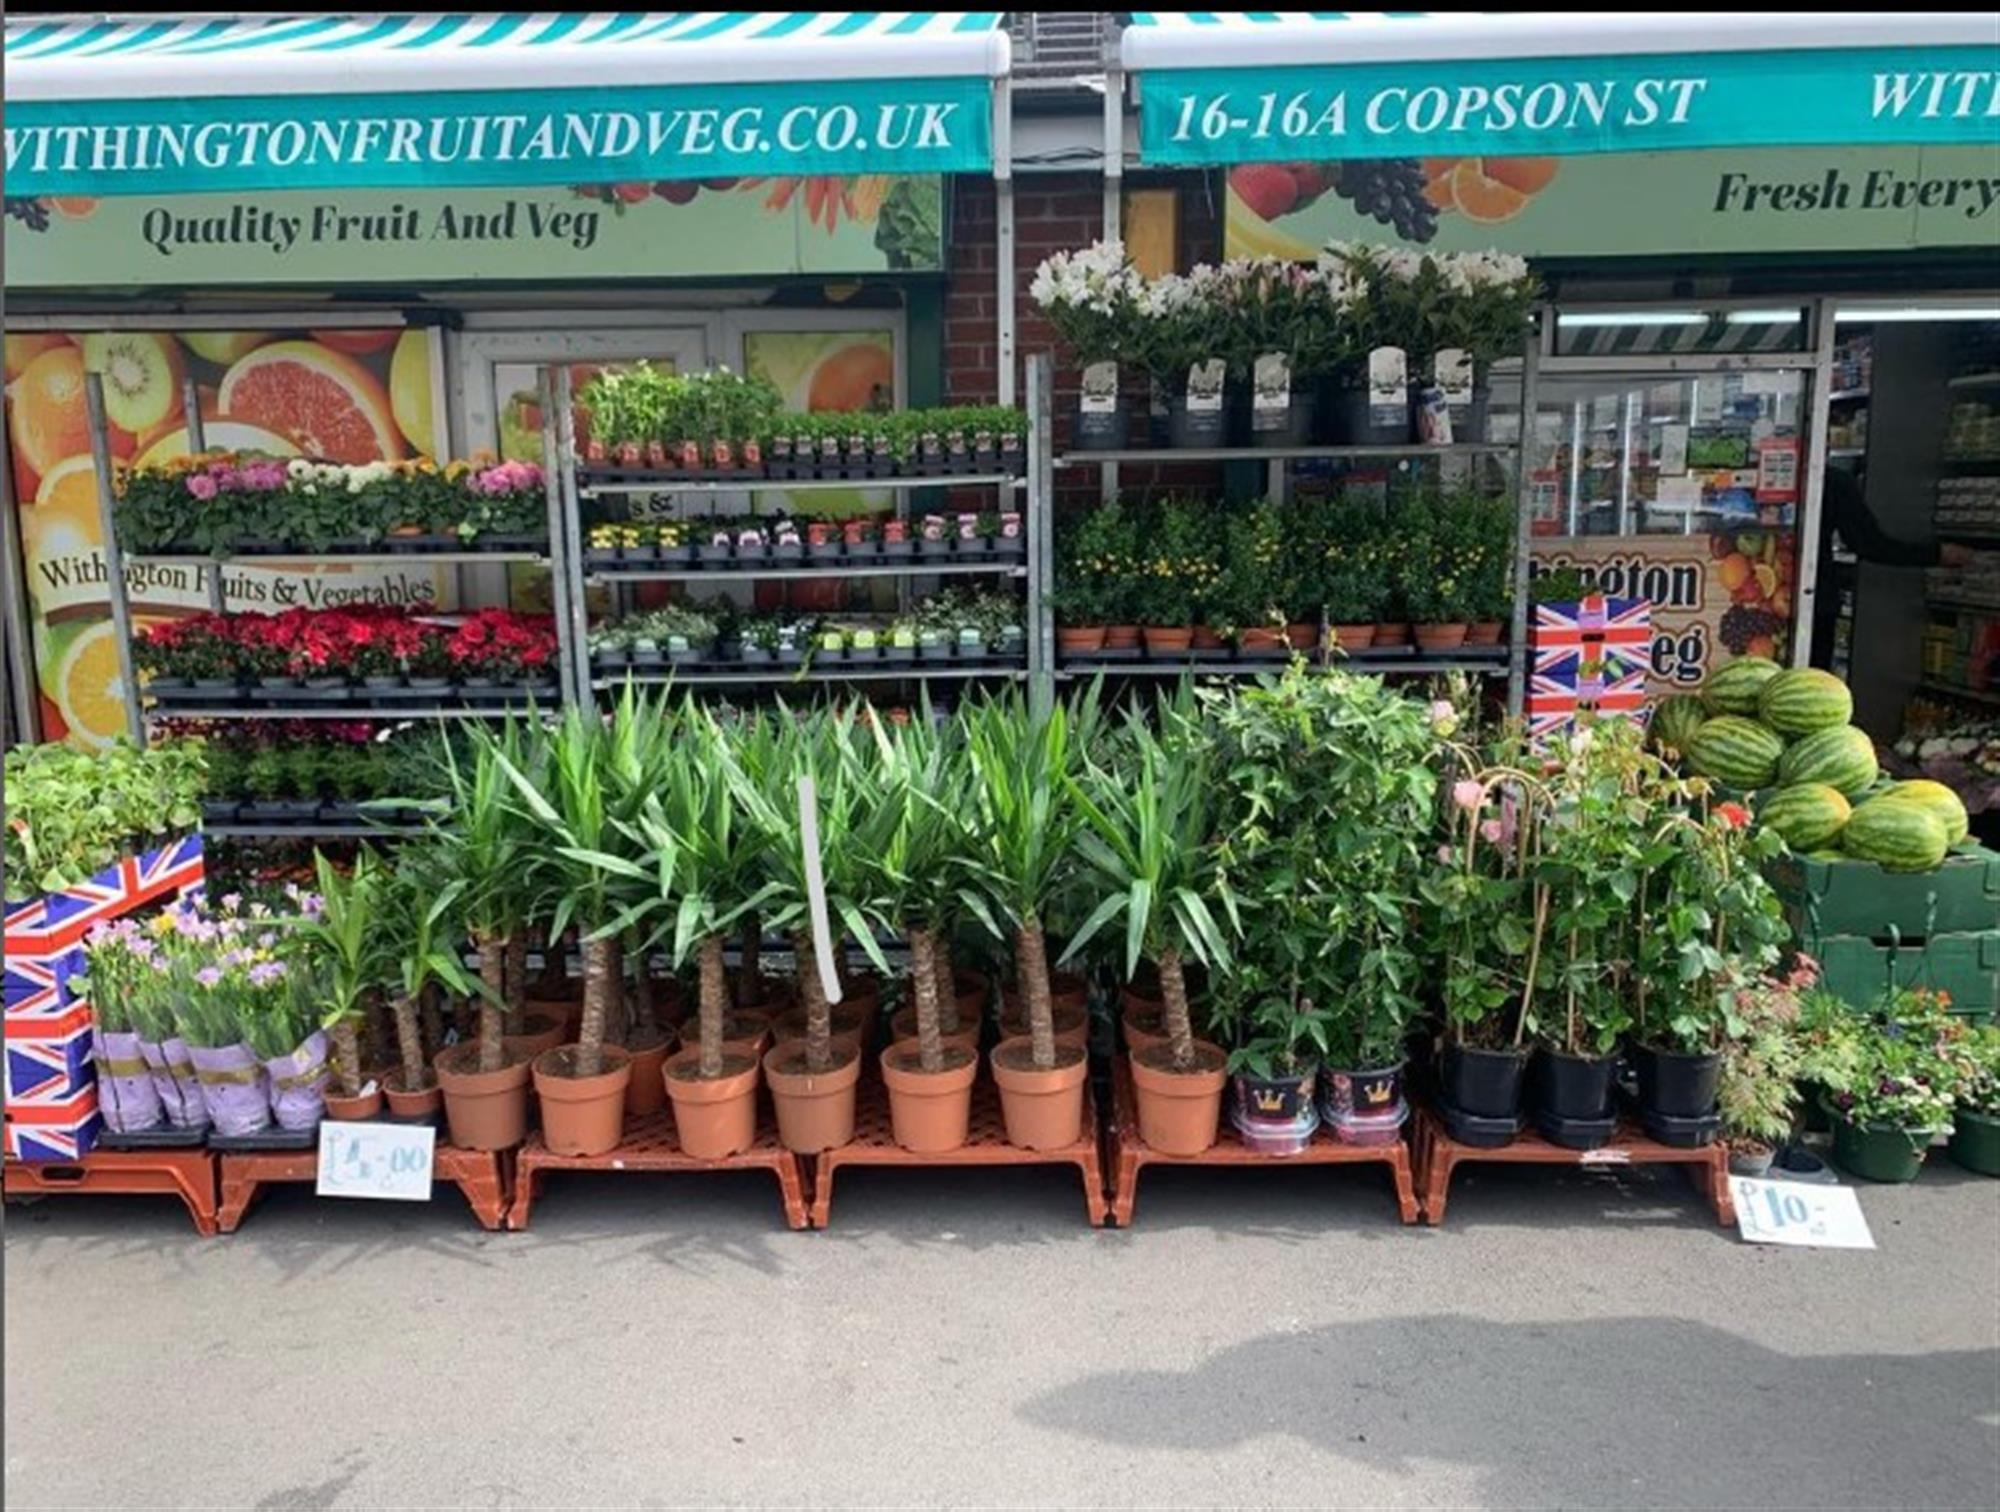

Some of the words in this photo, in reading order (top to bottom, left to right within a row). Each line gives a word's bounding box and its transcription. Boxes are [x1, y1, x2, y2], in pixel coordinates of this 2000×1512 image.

[1171, 88, 1346, 140] 16-16A
[1365, 80, 1615, 134] COPSON
[1624, 76, 1708, 127] ST
[1713, 167, 1852, 214] Fresh
[1860, 166, 2000, 219] Every
[142, 204, 302, 255] Quality
[310, 203, 422, 242] Fruit
[431, 202, 515, 241] And
[527, 200, 600, 250] Veg
[195, 565, 267, 602] Fuits
[272, 577, 298, 605] &
[303, 573, 437, 607] Vegetables
[1649, 628, 1703, 682] eg
